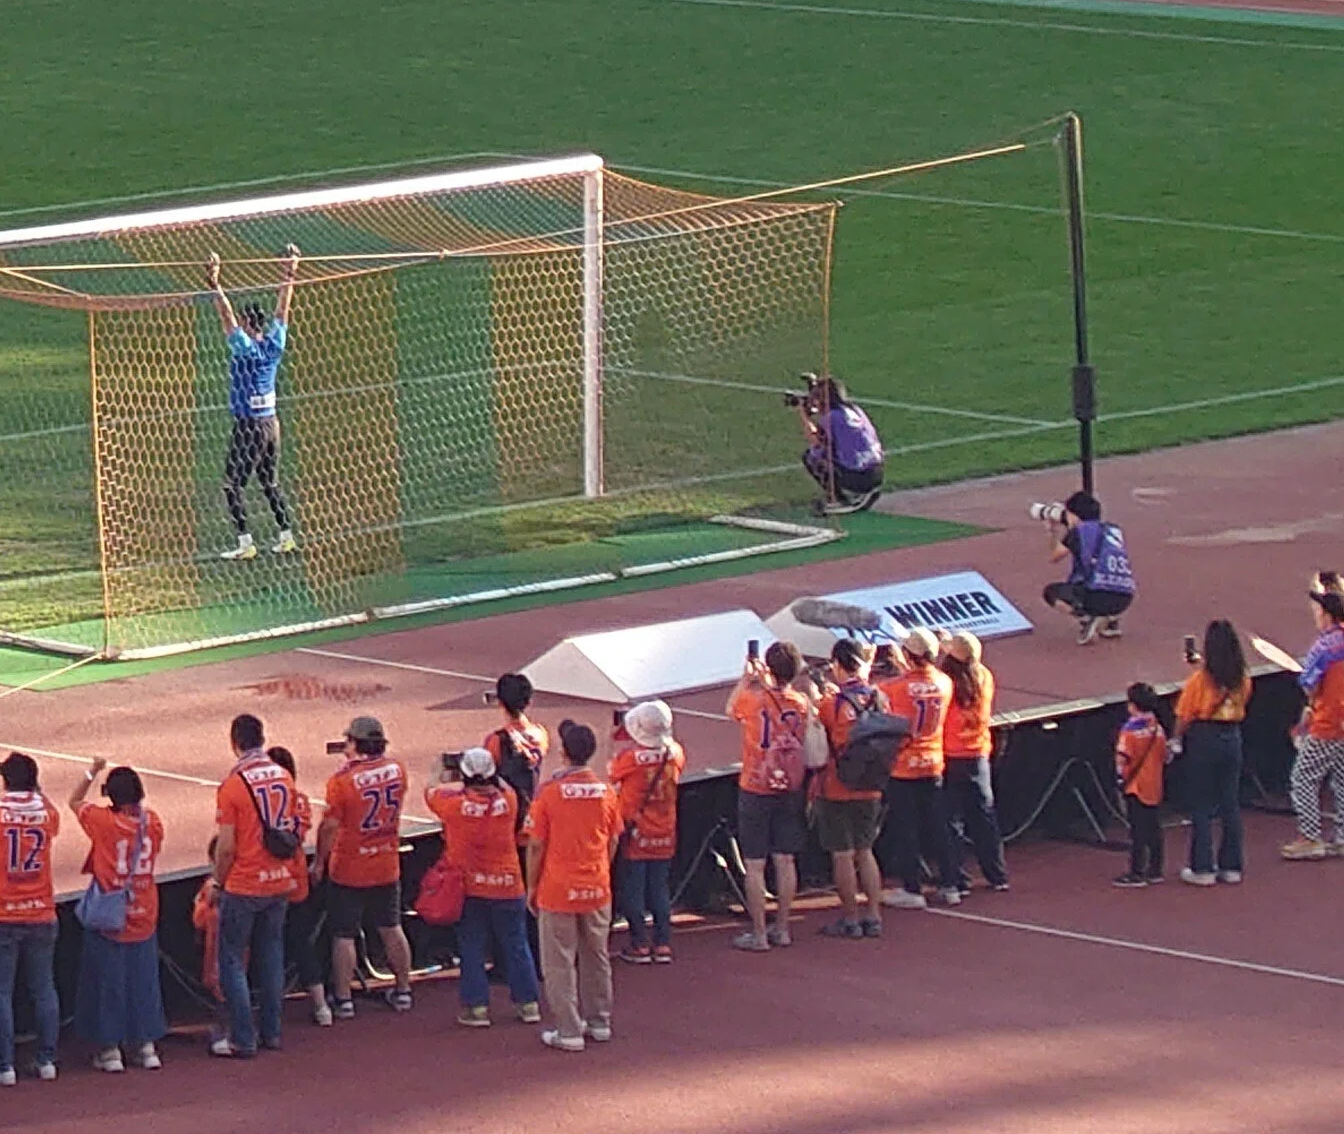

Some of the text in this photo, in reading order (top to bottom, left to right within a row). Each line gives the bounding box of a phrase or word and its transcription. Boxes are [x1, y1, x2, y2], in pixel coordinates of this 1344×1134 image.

[883, 591, 1002, 629] WINNER
[254, 783, 289, 831] 12
[360, 783, 402, 832] 25
[5, 826, 46, 873] 12
[115, 837, 154, 875] 12
